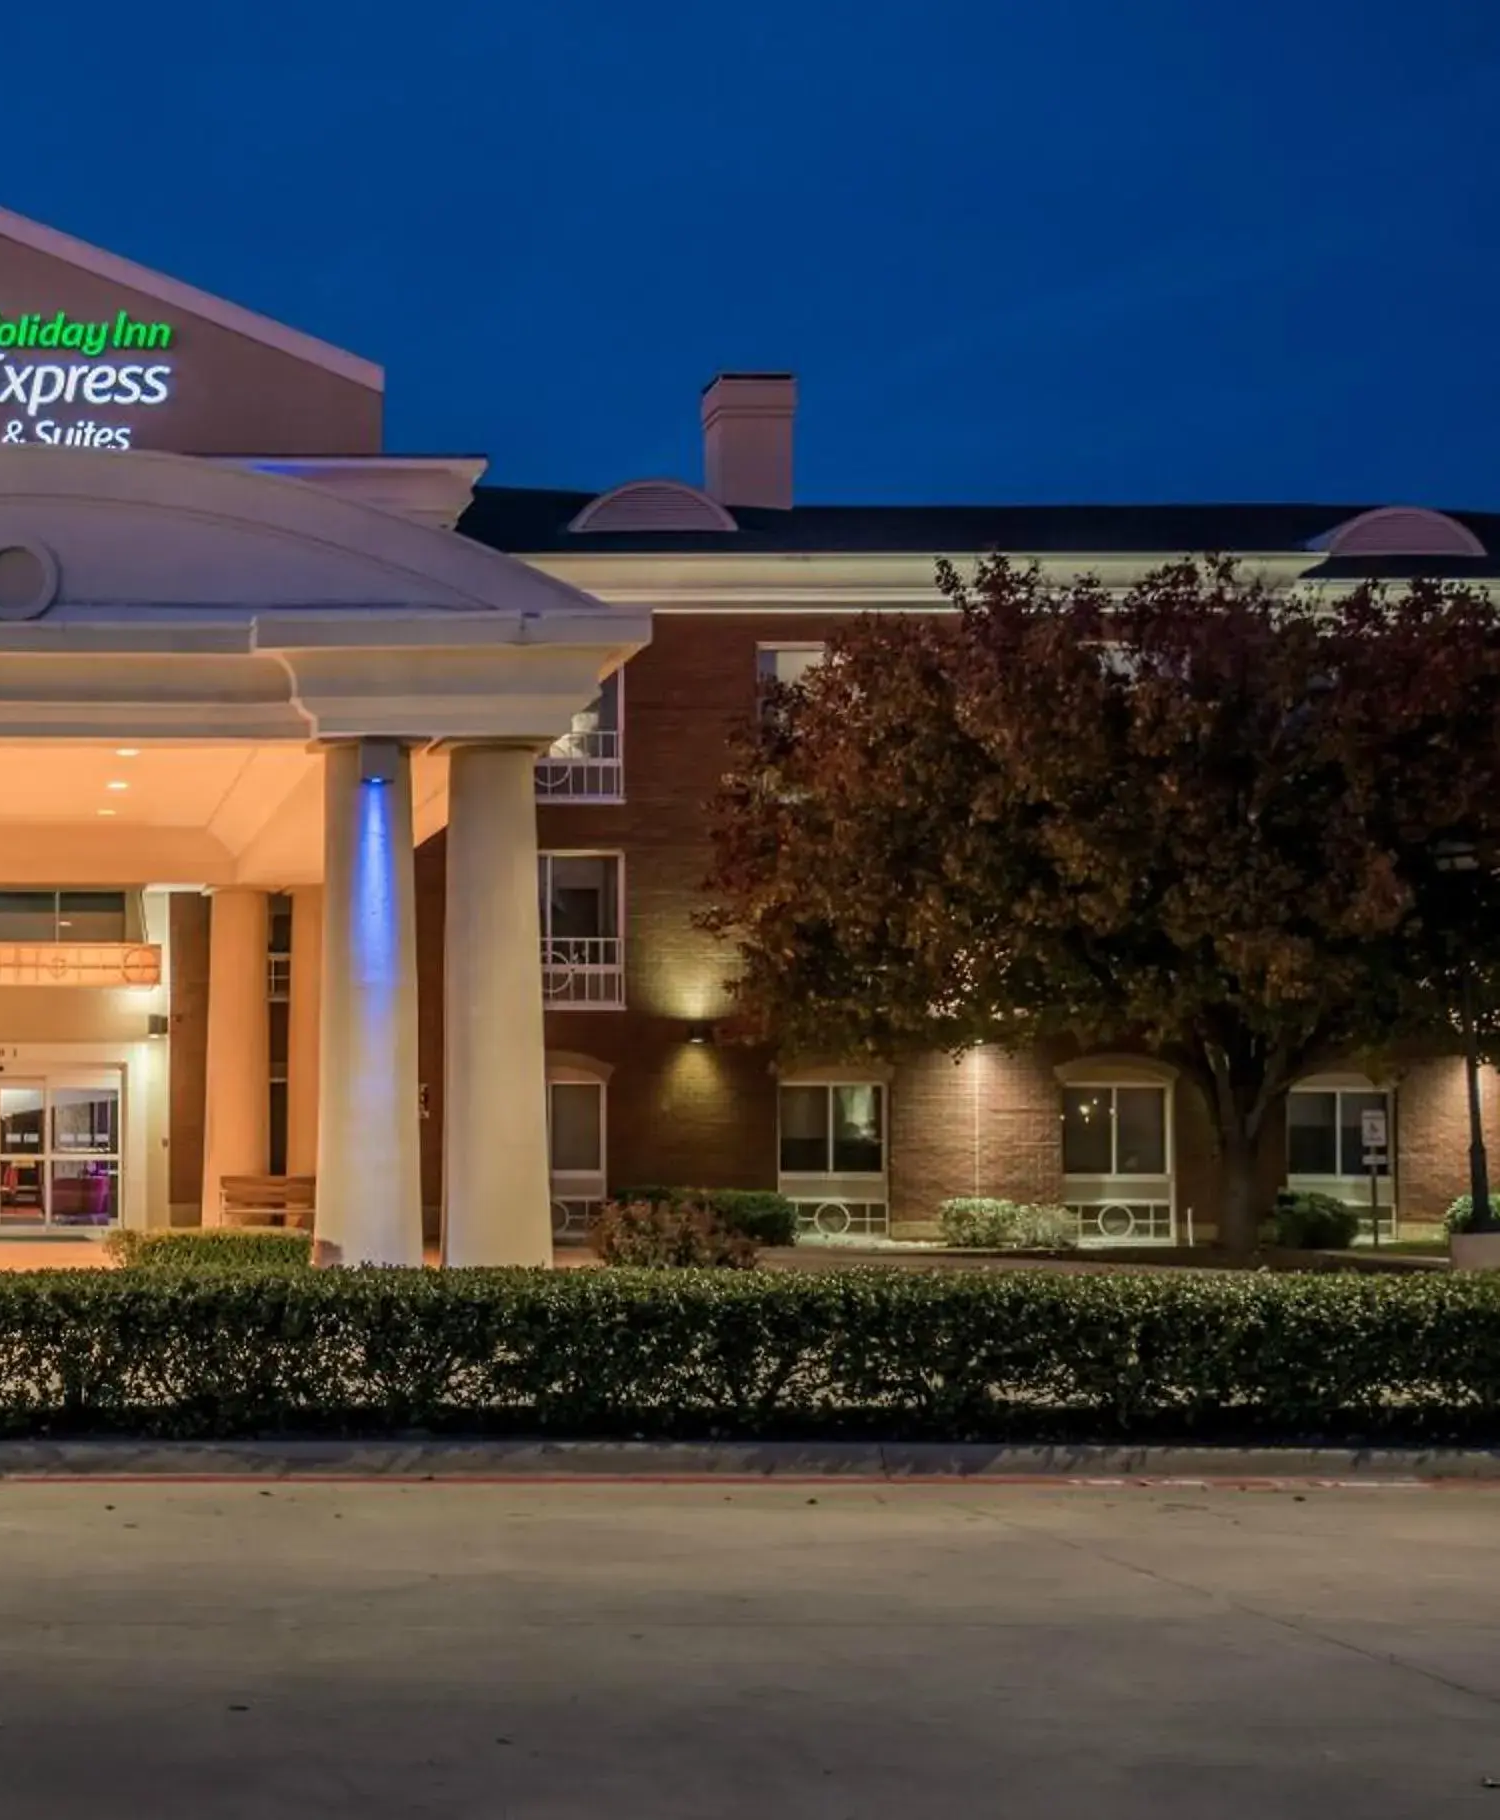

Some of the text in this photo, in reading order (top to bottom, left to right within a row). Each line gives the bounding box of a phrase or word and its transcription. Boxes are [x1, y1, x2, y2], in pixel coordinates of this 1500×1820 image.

[113, 310, 172, 348] Inn
[1, 419, 131, 450] & Suites
